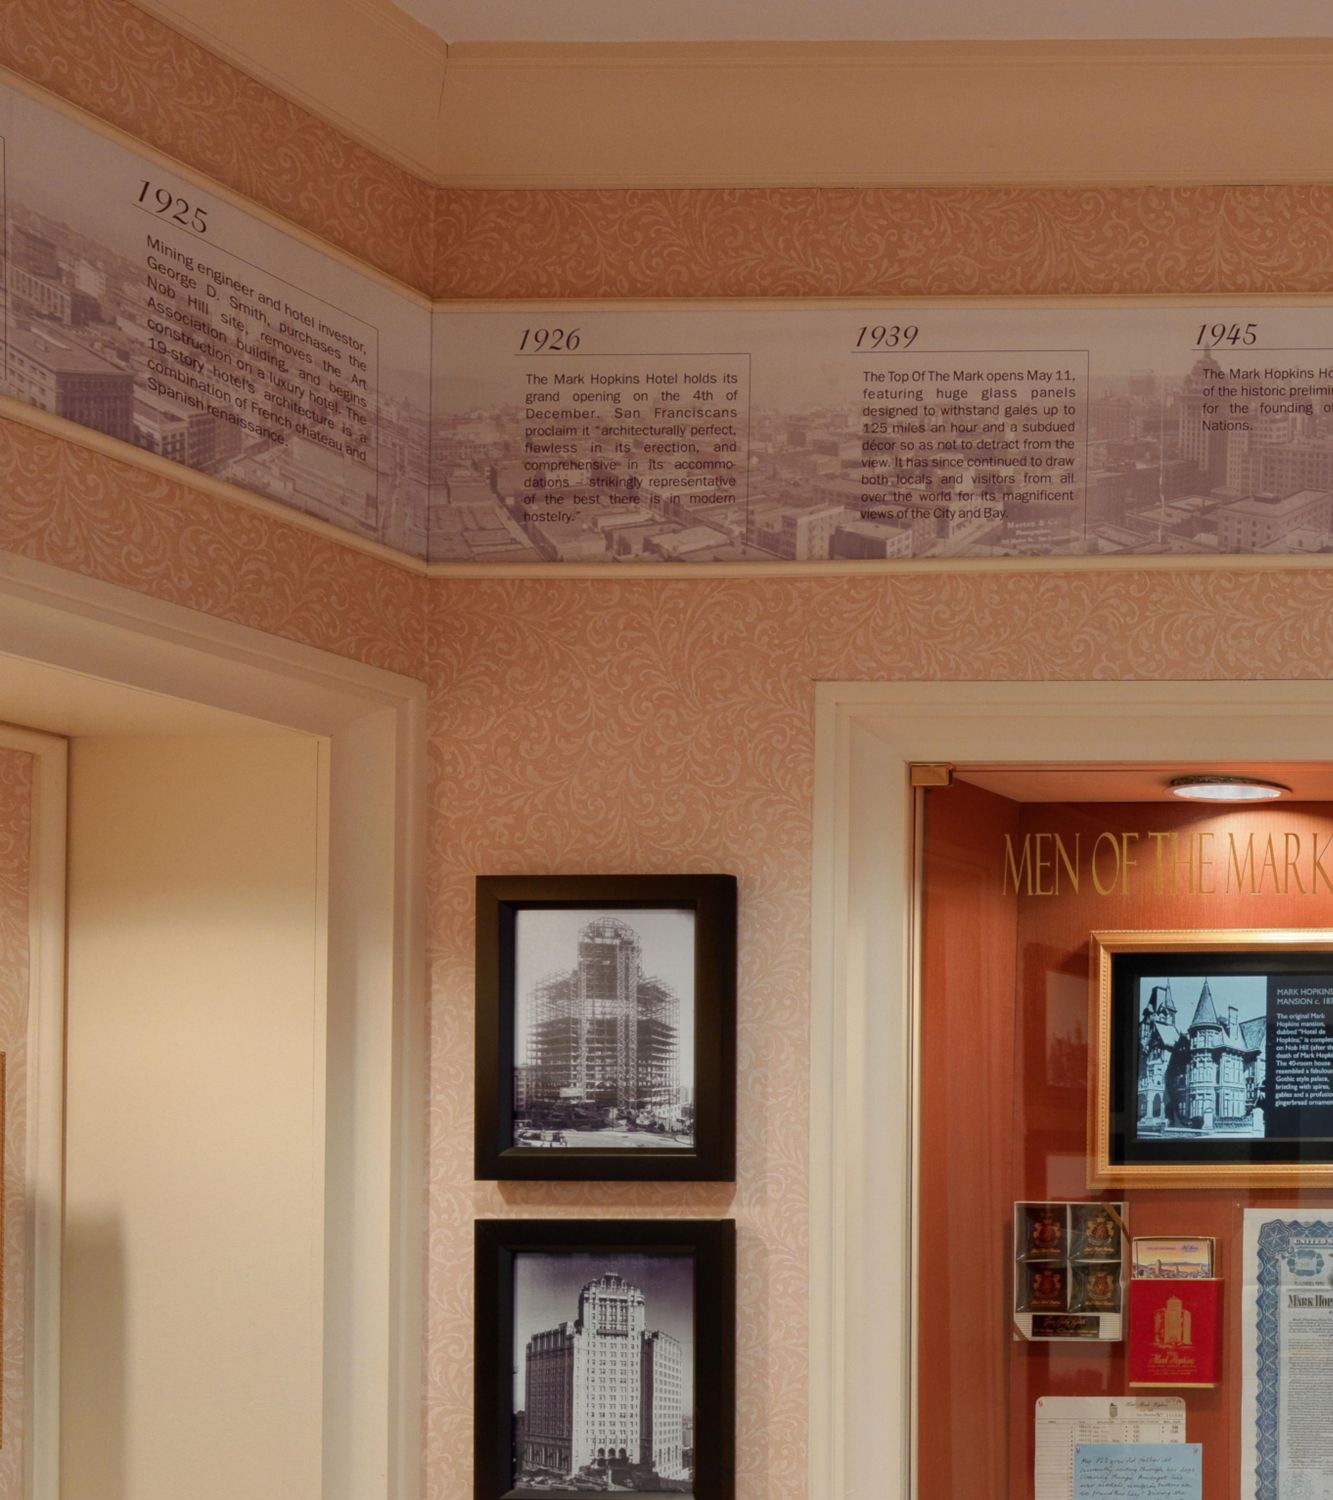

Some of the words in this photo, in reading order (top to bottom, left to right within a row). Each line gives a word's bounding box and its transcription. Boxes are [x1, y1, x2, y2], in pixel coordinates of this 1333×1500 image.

[138, 180, 208, 233] 1925
[519, 328, 581, 352] 1926
[855, 325, 919, 348] 1939
[1196, 323, 1258, 346] 1945
[1203, 369, 1224, 379] The
[1230, 369, 1260, 379] Mark
[1264, 368, 1313, 380] Hopkins
[1203, 385, 1215, 396] of
[1218, 386, 1237, 396] the
[1241, 385, 1286, 396] historic
[1202, 403, 1219, 414] for
[1230, 403, 1248, 413] the
[1260, 403, 1312, 415] founding
[1202, 420, 1253, 431] Nations.
[1002, 832, 1080, 896] MEN
[1092, 832, 1139, 895] OF
[1148, 832, 1215, 894] THE
